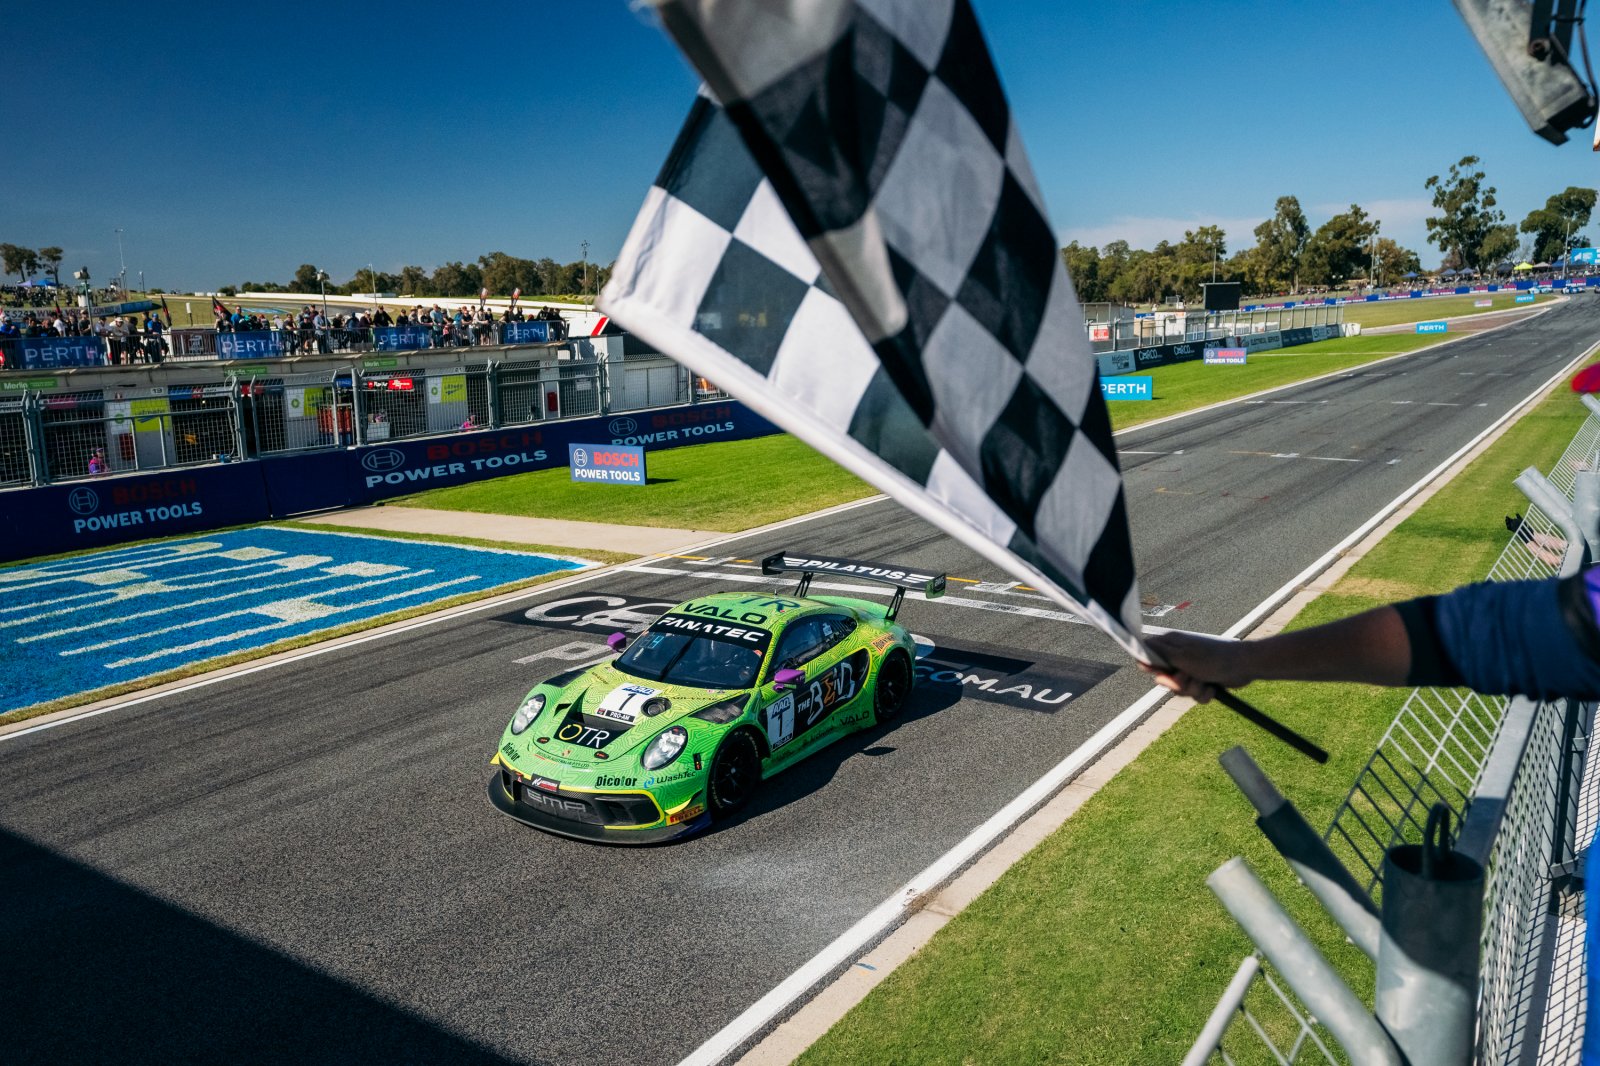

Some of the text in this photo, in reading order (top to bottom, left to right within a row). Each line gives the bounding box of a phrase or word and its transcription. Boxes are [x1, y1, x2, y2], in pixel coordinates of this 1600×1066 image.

[381, 332, 425, 345] PERTH
[507, 328, 545, 341] PERTH
[24, 345, 98, 362] PERTH
[222, 340, 283, 353] PERTH
[1099, 383, 1146, 395] PERTH
[652, 407, 732, 428] BOSCH
[612, 421, 735, 446] POWER TOOLS
[427, 431, 544, 461] BOSCH
[593, 451, 639, 467] BOSCH
[365, 450, 548, 488] POWER TOOLS
[574, 469, 641, 482] POWER TOOLS
[112, 479, 197, 505] BOSCH
[74, 502, 203, 534] POWER TOOLS
[801, 559, 906, 580] PILATUS
[684, 603, 768, 625] VALO
[657, 617, 766, 642] FANATEC
[618, 693, 638, 711] 1
[798, 698, 811, 714] THE
[609, 711, 631, 721] PRO-AM
[777, 713, 783, 738] 1
[840, 710, 870, 726] VALO
[558, 723, 610, 749] OTR
